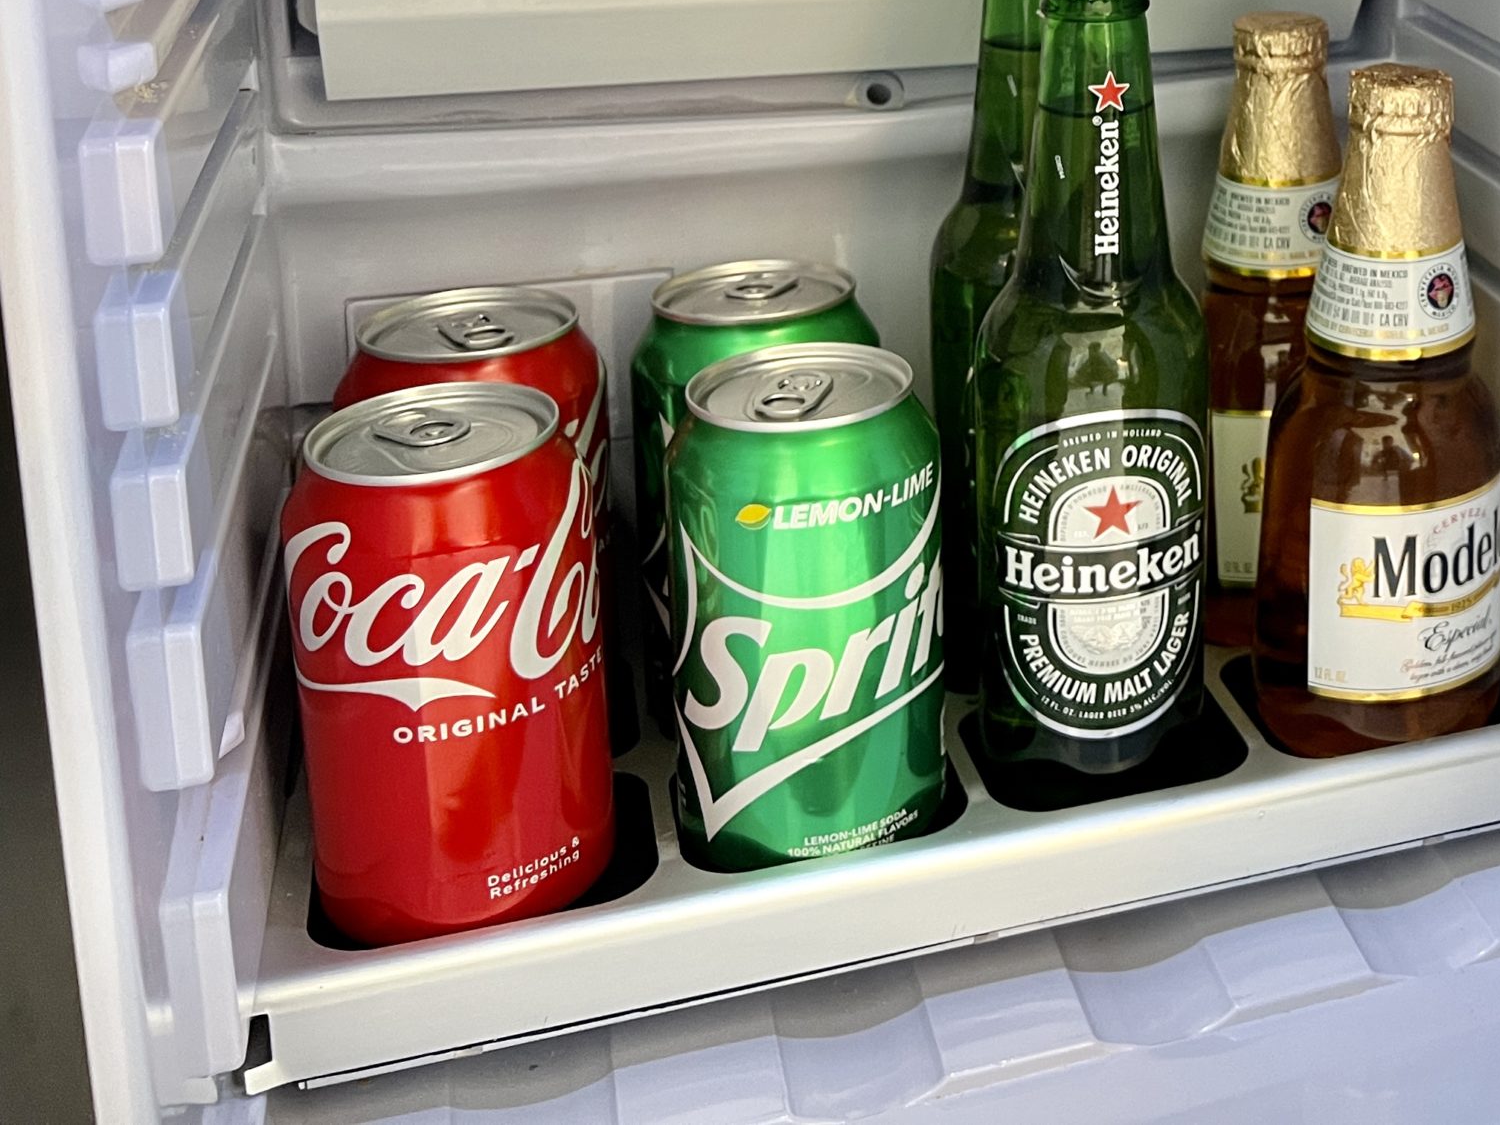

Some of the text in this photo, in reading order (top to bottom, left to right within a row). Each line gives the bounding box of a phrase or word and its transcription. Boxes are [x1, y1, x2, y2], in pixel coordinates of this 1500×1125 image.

[1095, 120, 1120, 256] Heineken
[1342, 263, 1368, 276] BREWED
[1370, 269, 1378, 277] IN
[1380, 270, 1408, 278] MEXICO
[1379, 313, 1409, 327] CA CRV
[1063, 429, 1162, 448] BREWED IN HOLLAND
[773, 461, 933, 530] LEMON-LIME
[1019, 447, 1111, 524] HEINEKEN
[1121, 445, 1192, 507] ORIGINAL
[1005, 533, 1200, 594] Heineken
[684, 548, 943, 752] Sprit
[1418, 603, 1492, 653] Especial
[1020, 633, 1097, 704] PREMIUM
[1103, 668, 1153, 704] MALT
[1153, 612, 1190, 677] LAGER
[393, 696, 546, 744] ORIGINAL
[788, 846, 821, 857] 100%
[823, 833, 876, 855] NATURAL
[878, 809, 918, 838] FLAVORS
[804, 819, 879, 846] LEMON-LIME
[879, 808, 907, 829] SODA
[487, 836, 580, 888] Delicious &
[490, 850, 580, 900] Refreshing
